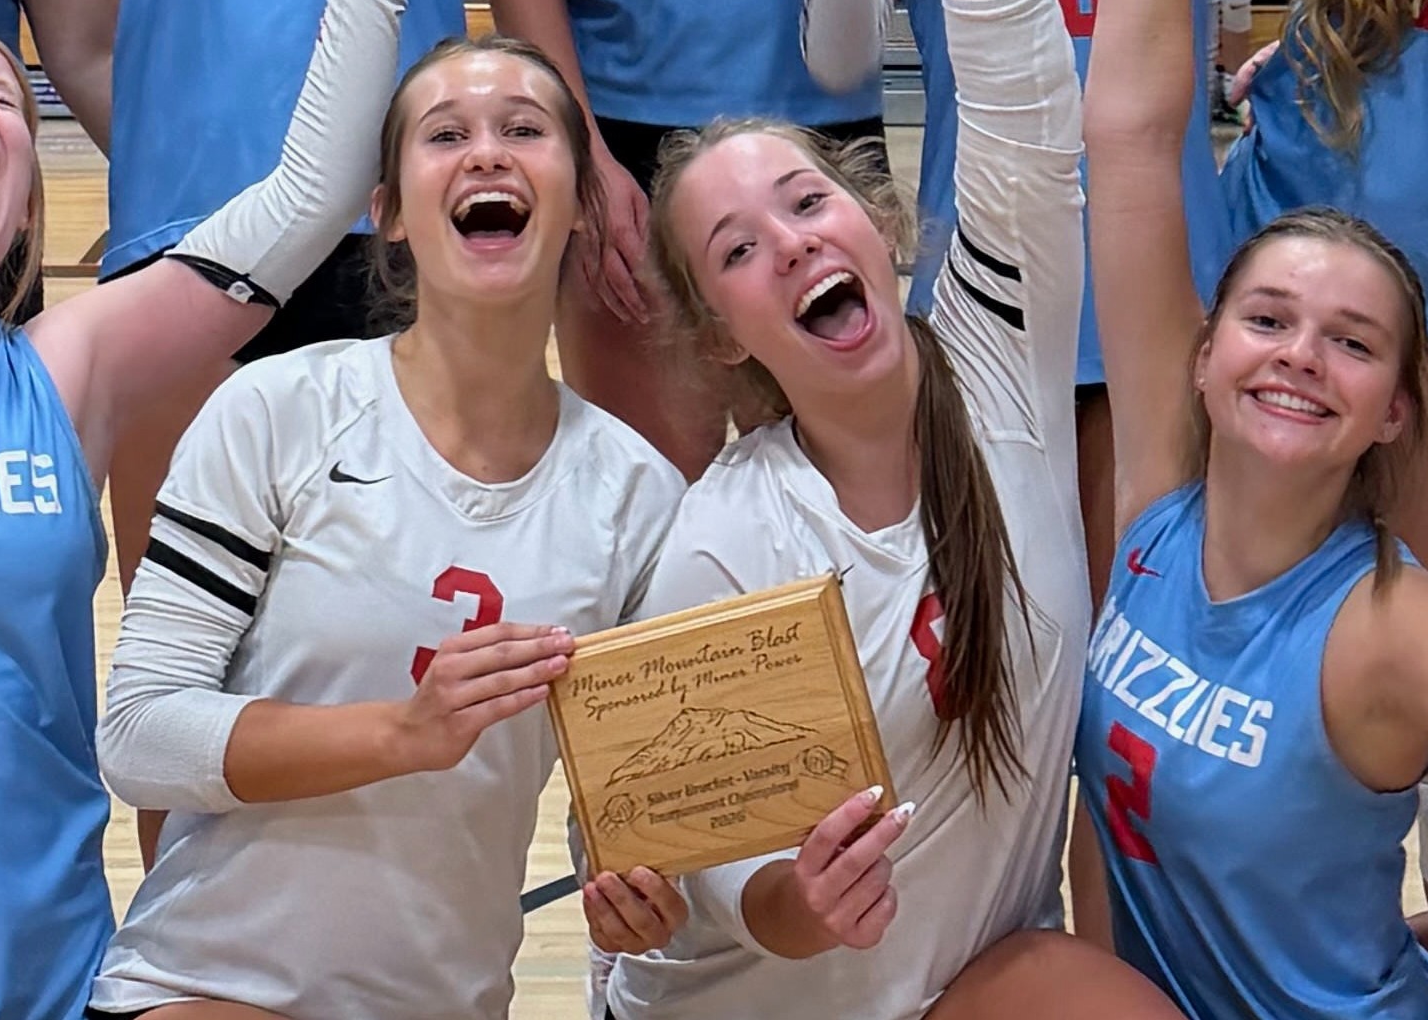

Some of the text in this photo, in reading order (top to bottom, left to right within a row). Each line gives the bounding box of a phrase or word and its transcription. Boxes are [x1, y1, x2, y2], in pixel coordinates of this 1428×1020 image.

[570, 622, 802, 697] Miner Mountain Blast
[584, 683, 664, 721] Sponsored
[671, 677, 688, 704] by
[750, 653, 803, 673] Power
[1106, 720, 1159, 866] 2
